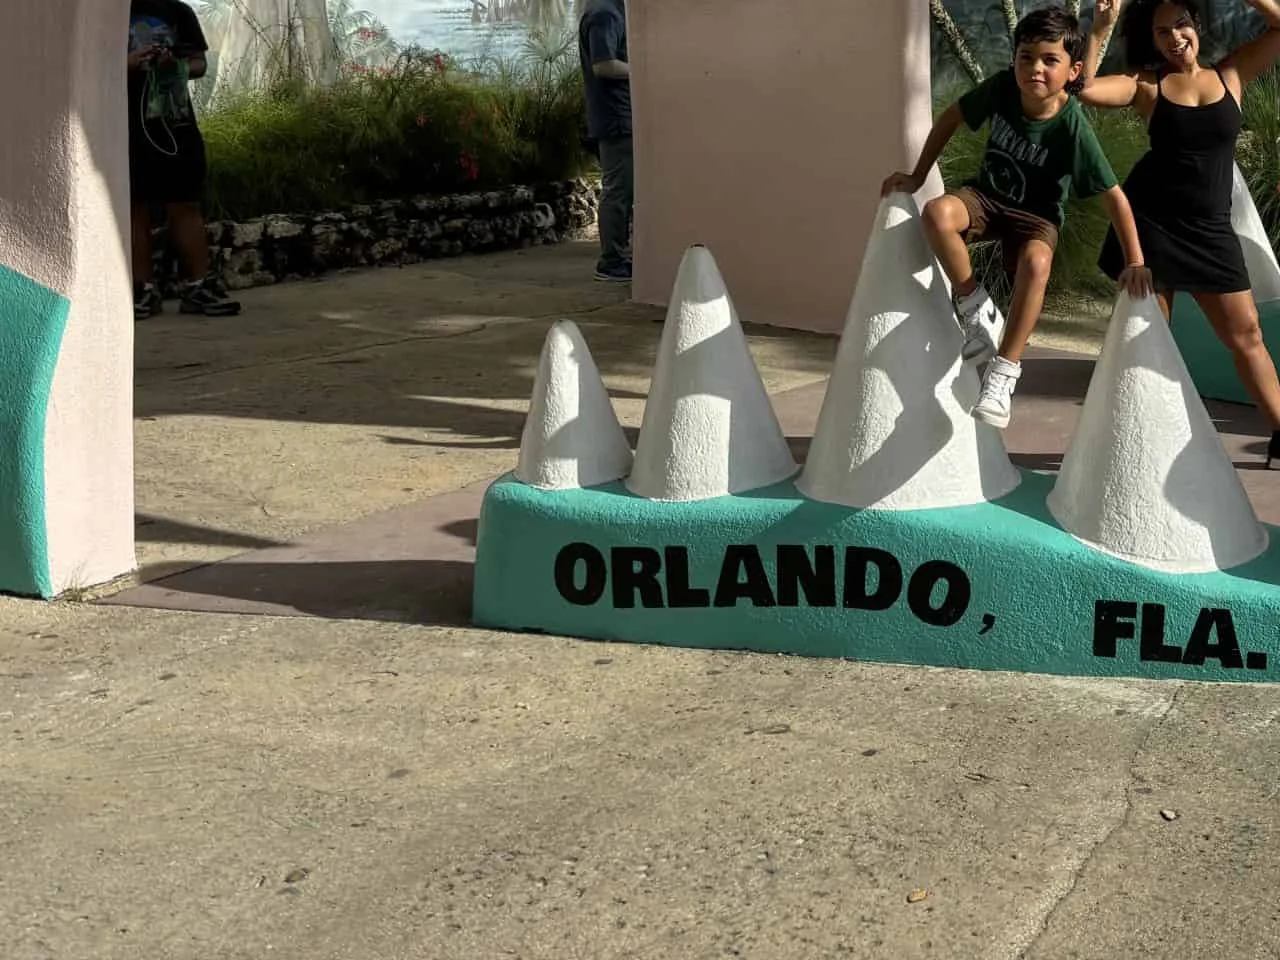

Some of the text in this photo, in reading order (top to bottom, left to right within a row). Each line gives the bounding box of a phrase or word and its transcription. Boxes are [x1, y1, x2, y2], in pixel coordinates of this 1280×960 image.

[990, 113, 1049, 167] NIRVANA
[553, 541, 997, 636] ORLANDO,
[1091, 599, 1268, 671] FLA.
